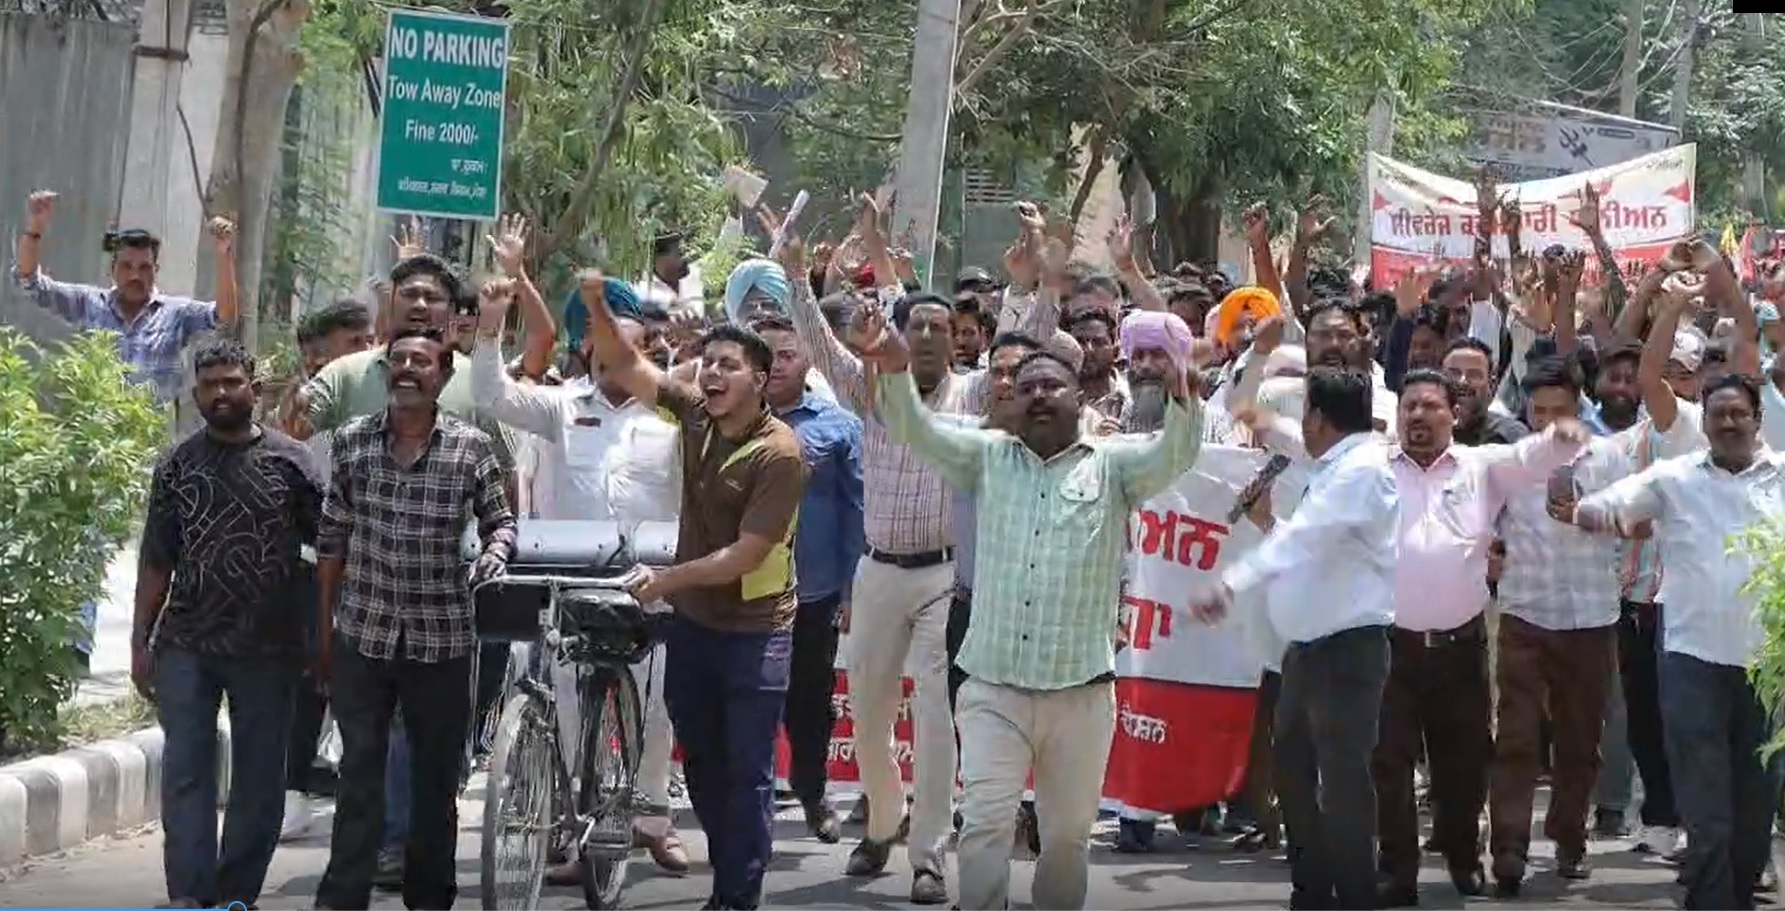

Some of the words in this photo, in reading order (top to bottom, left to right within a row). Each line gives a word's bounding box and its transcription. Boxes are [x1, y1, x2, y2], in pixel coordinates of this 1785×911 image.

[391, 27, 418, 59] NO
[424, 30, 504, 69] PARKING
[389, 75, 418, 99] Tow
[421, 78, 461, 109] Away
[465, 83, 501, 109] Zone
[405, 120, 435, 141] Fine
[439, 123, 478, 145] 2000/-
